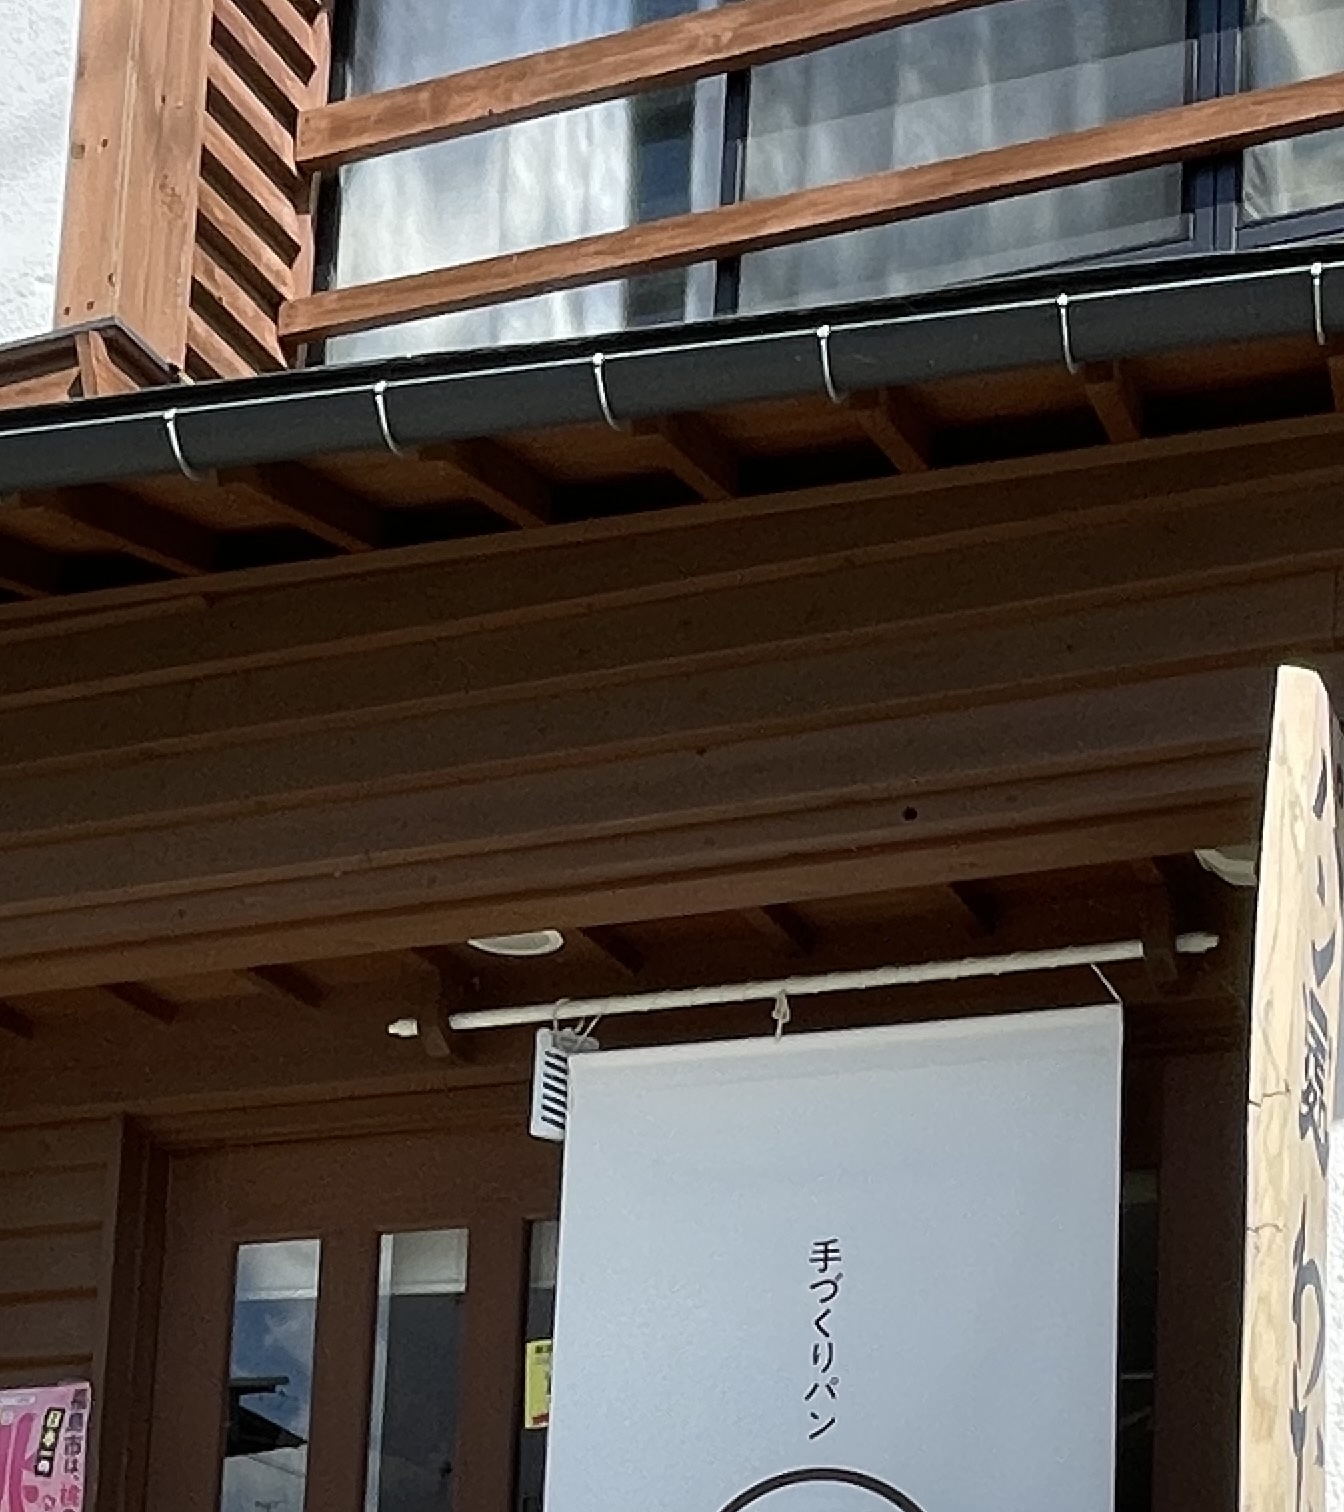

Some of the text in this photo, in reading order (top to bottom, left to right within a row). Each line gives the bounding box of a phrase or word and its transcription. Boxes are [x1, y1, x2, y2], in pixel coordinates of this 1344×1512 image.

[805, 1239, 843, 1439] 手づくりパン
